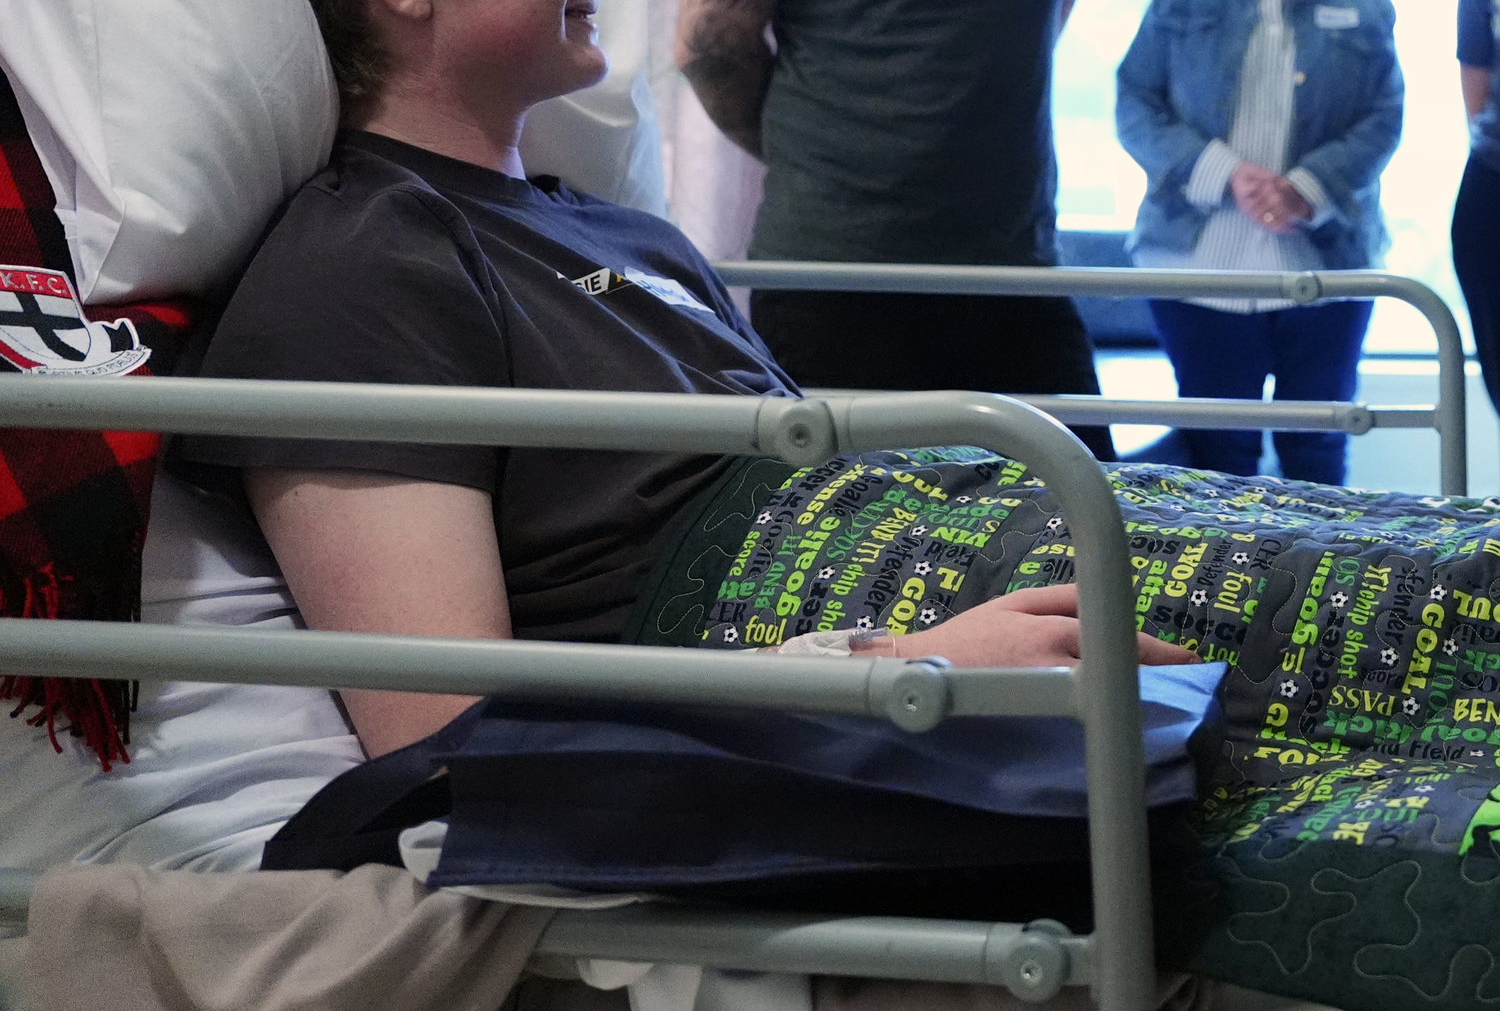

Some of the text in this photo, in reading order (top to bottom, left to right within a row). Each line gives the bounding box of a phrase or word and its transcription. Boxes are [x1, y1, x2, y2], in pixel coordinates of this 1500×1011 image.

[729, 530, 761, 577] score
[754, 561, 787, 609] BEND
[777, 535, 803, 557] IT!
[777, 516, 841, 617] goalie
[1164, 542, 1209, 598] GOAL
[1197, 539, 1235, 587] Defender
[830, 563, 866, 597] chip
[1213, 571, 1254, 614] foul
[745, 614, 788, 646] foul
[1337, 589, 1380, 679] chip shot
[1402, 602, 1445, 696] GOAL
[1300, 611, 1345, 735] soccer
[1328, 684, 1397, 716] PASS
[1323, 710, 1414, 745] kick
